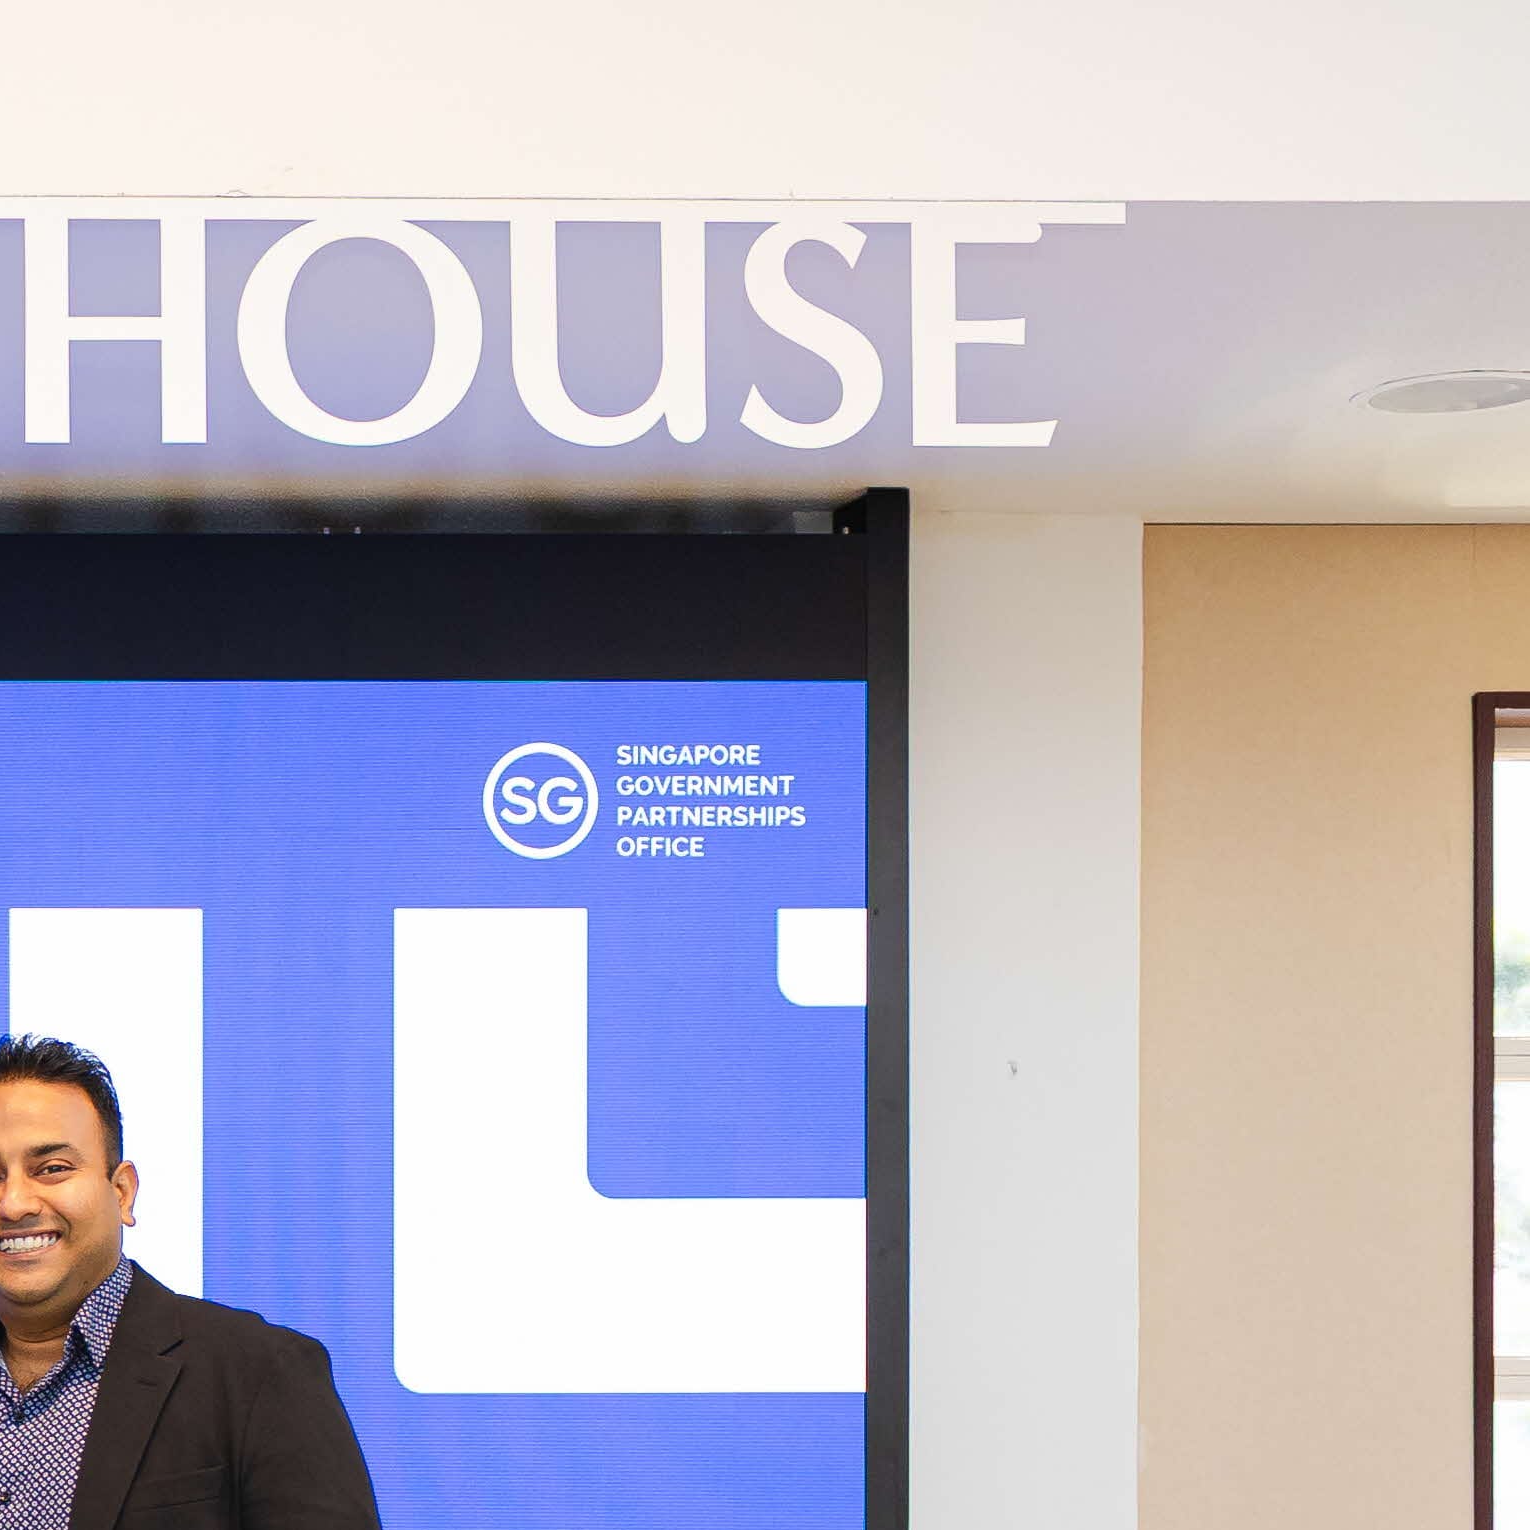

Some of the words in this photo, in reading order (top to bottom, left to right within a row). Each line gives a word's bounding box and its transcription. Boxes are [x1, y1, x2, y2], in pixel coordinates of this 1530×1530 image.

[616, 744, 761, 766] SINGAPORE
[616, 775, 795, 797] GOVERNMENT
[499, 776, 584, 826] SG
[617, 805, 807, 827] PARTNERSHIPS
[616, 836, 705, 857] OFFICE
